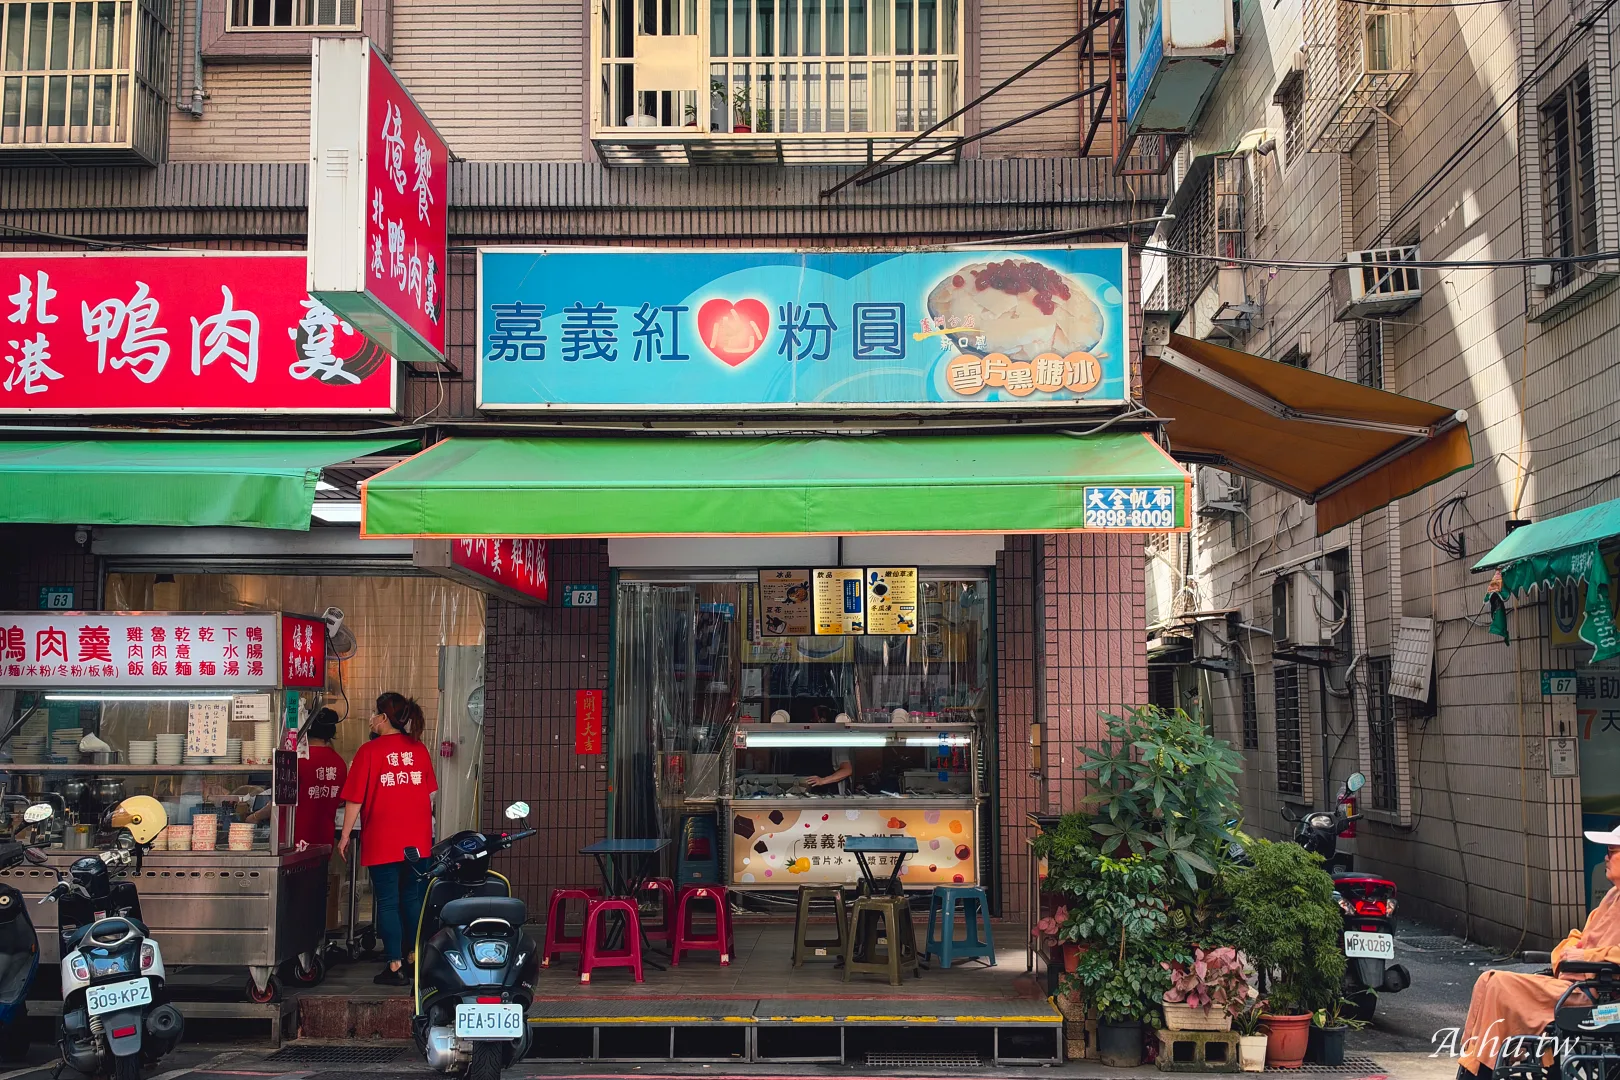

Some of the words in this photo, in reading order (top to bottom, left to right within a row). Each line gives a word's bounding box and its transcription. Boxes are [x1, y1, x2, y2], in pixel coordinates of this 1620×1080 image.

[370, 186, 385, 279] 北港
[388, 217, 438, 326] 鴨肉羹
[3, 270, 64, 394] 北港
[81, 280, 361, 385] 鴨肉羹
[488, 300, 906, 362] 嘉義紅心粉圓
[951, 357, 1096, 390] 雪片黑糖冰
[1086, 510, 1172, 527] 2898-8009
[1087, 487, 1172, 510] 大全帆布
[53, 594, 68, 606] 63
[577, 592, 593, 604] 63
[126, 626, 144, 676] 雞肉飯
[150, 626, 168, 676] 魯肉飯
[174, 626, 193, 676] 乾意麵
[198, 626, 216, 676] 乾麵
[222, 627, 240, 676] 下水湯
[246, 626, 264, 676] 鴨腸湯
[1556, 679, 1571, 692] 67
[581, 695, 598, 752] 開工大吉
[380, 771, 422, 786] 鴨肉羹
[1346, 937, 1391, 952] MPX-0289
[458, 1012, 520, 1029] PEA-5168
